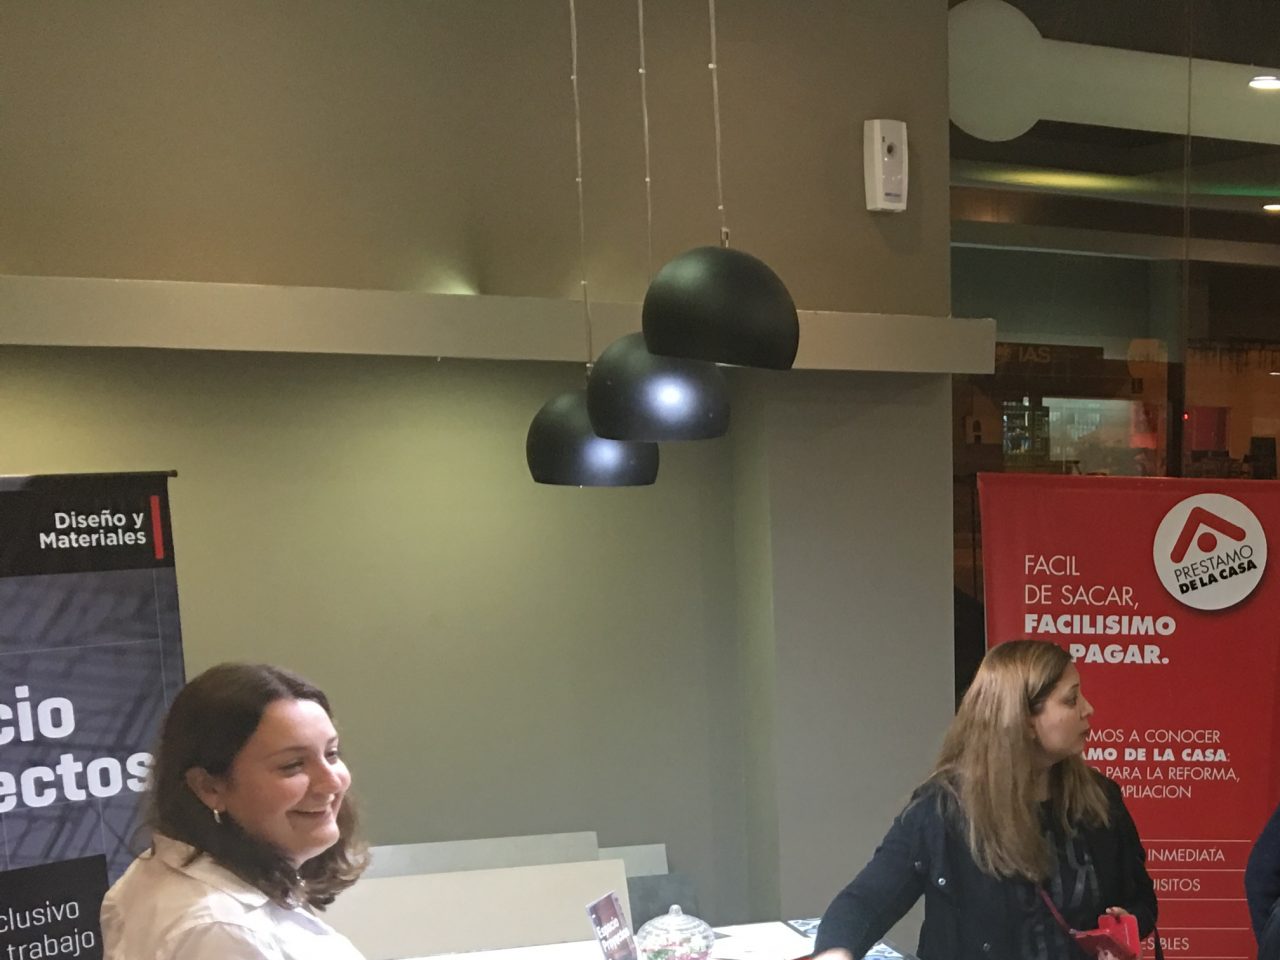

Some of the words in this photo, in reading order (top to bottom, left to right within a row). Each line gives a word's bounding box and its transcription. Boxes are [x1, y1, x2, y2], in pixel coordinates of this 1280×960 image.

[55, 509, 126, 529] Diseño
[133, 512, 144, 529] y
[40, 529, 146, 550] Materiales
[1024, 554, 1080, 576] FACIL
[1174, 544, 1253, 583] PRESTAMO
[1178, 578, 1198, 595] DE
[1198, 573, 1218, 589] LA
[1219, 559, 1257, 581] CASA
[1024, 584, 1052, 605] DE
[1060, 585, 1140, 610] SACAR,
[1024, 613, 1176, 636] FACILISIMO
[1069, 643, 1169, 664] PAGAR.
[1128, 729, 1140, 743] A
[1144, 729, 1221, 744] CONOCER
[1124, 748, 1146, 761] DE
[1153, 748, 1175, 761] LA
[1106, 766, 1142, 780] PARA
[1147, 766, 1164, 780] LA
[1168, 766, 1241, 783] REFORMA,
[1147, 848, 1225, 862] INMEDIATA
